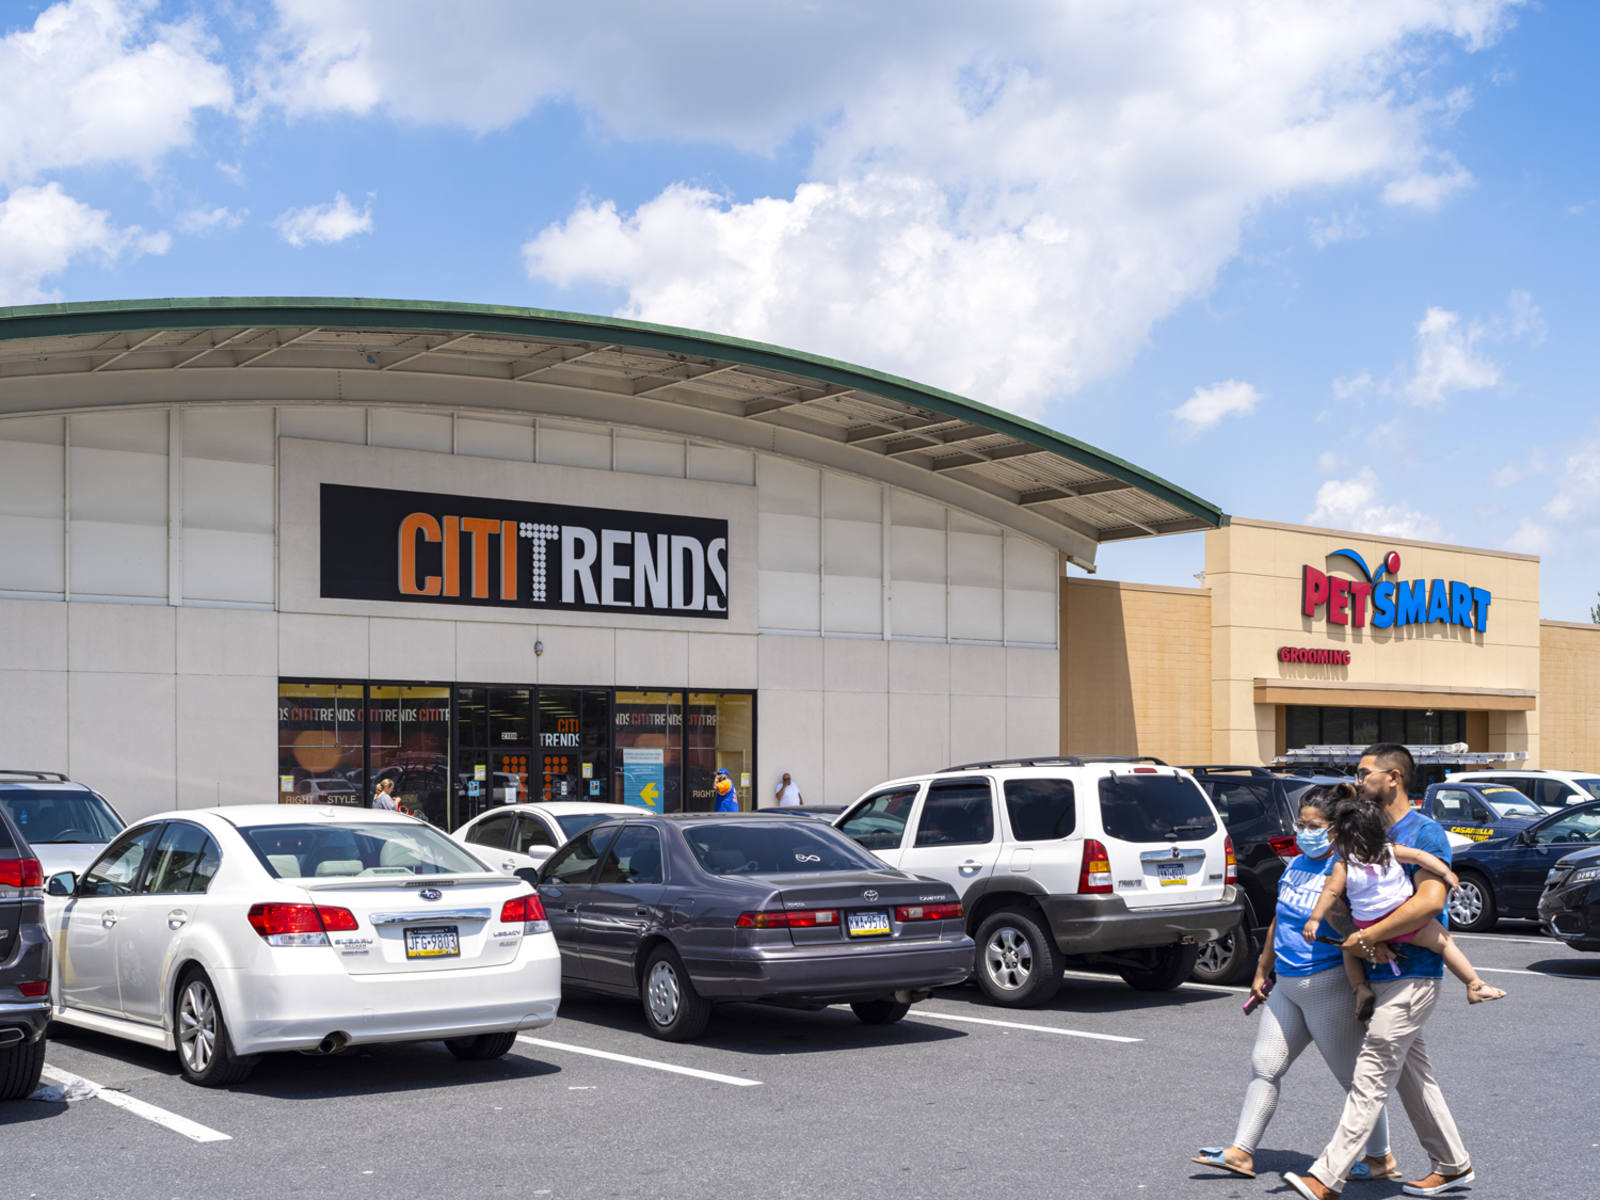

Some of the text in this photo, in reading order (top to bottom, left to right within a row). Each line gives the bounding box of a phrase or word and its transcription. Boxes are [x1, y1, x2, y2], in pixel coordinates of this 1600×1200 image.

[1302, 564, 1492, 633] PETSMART
[1278, 646, 1351, 666] GROOMING
[558, 719, 579, 733] CITI
[539, 733, 580, 747] TRENDS
[692, 790, 715, 799] RIGHT
